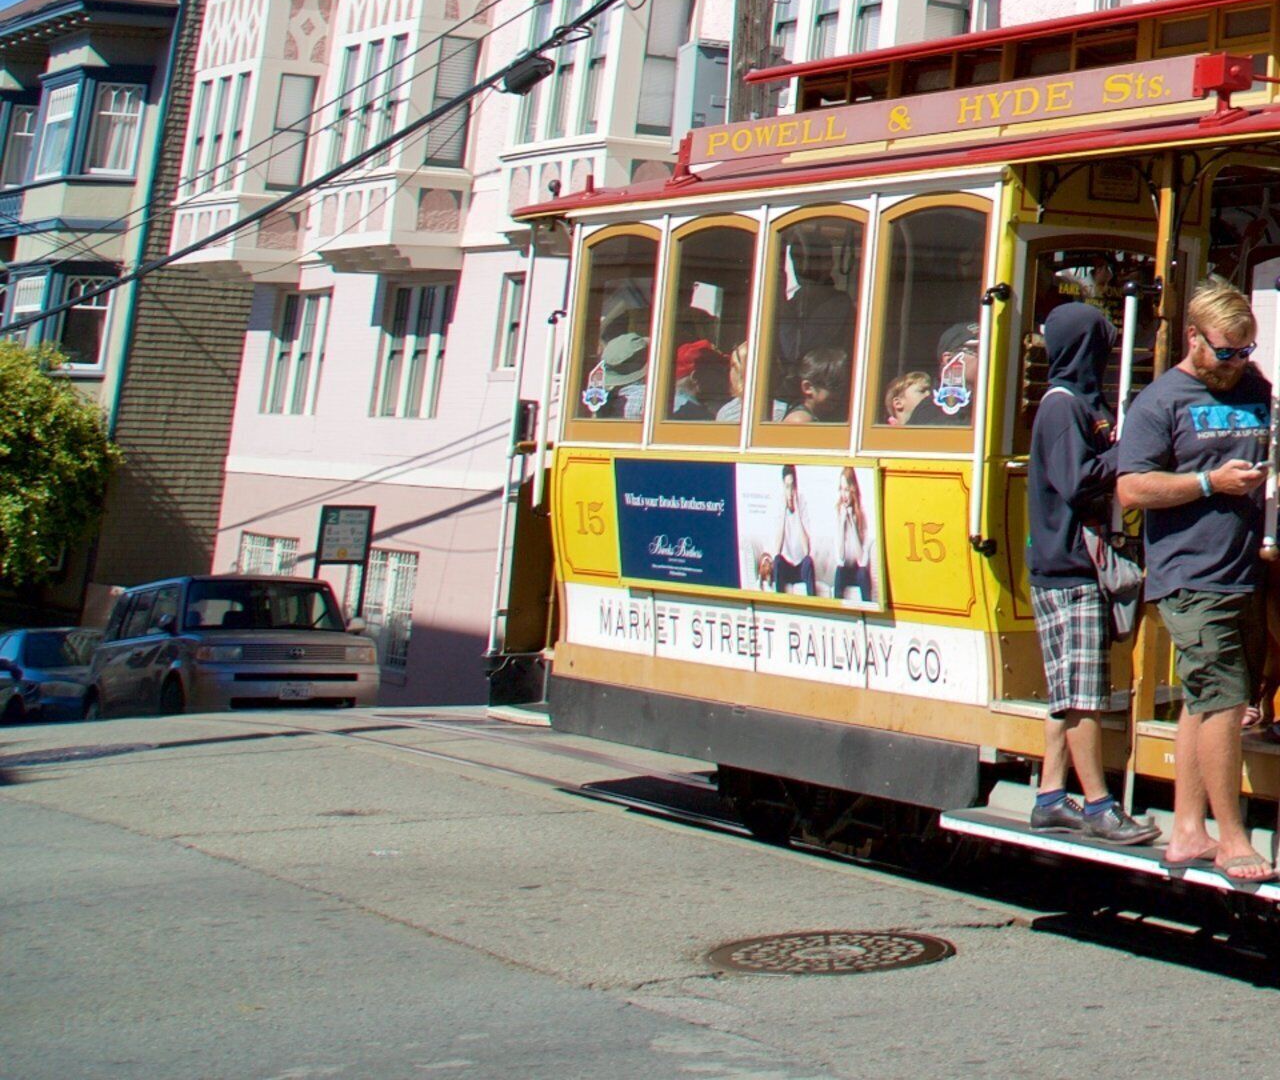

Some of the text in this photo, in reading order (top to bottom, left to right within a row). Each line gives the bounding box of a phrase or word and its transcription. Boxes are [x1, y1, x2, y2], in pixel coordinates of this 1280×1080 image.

[706, 71, 1172, 156] POWELL & HYDE Sts.
[575, 500, 606, 536] 15
[624, 492, 725, 516] What's your Brooks Brothers story?
[904, 521, 947, 563] 15
[599, 598, 948, 684] MARKET STREET RAILWAY CO.
[1164, 752, 1176, 764] TW
